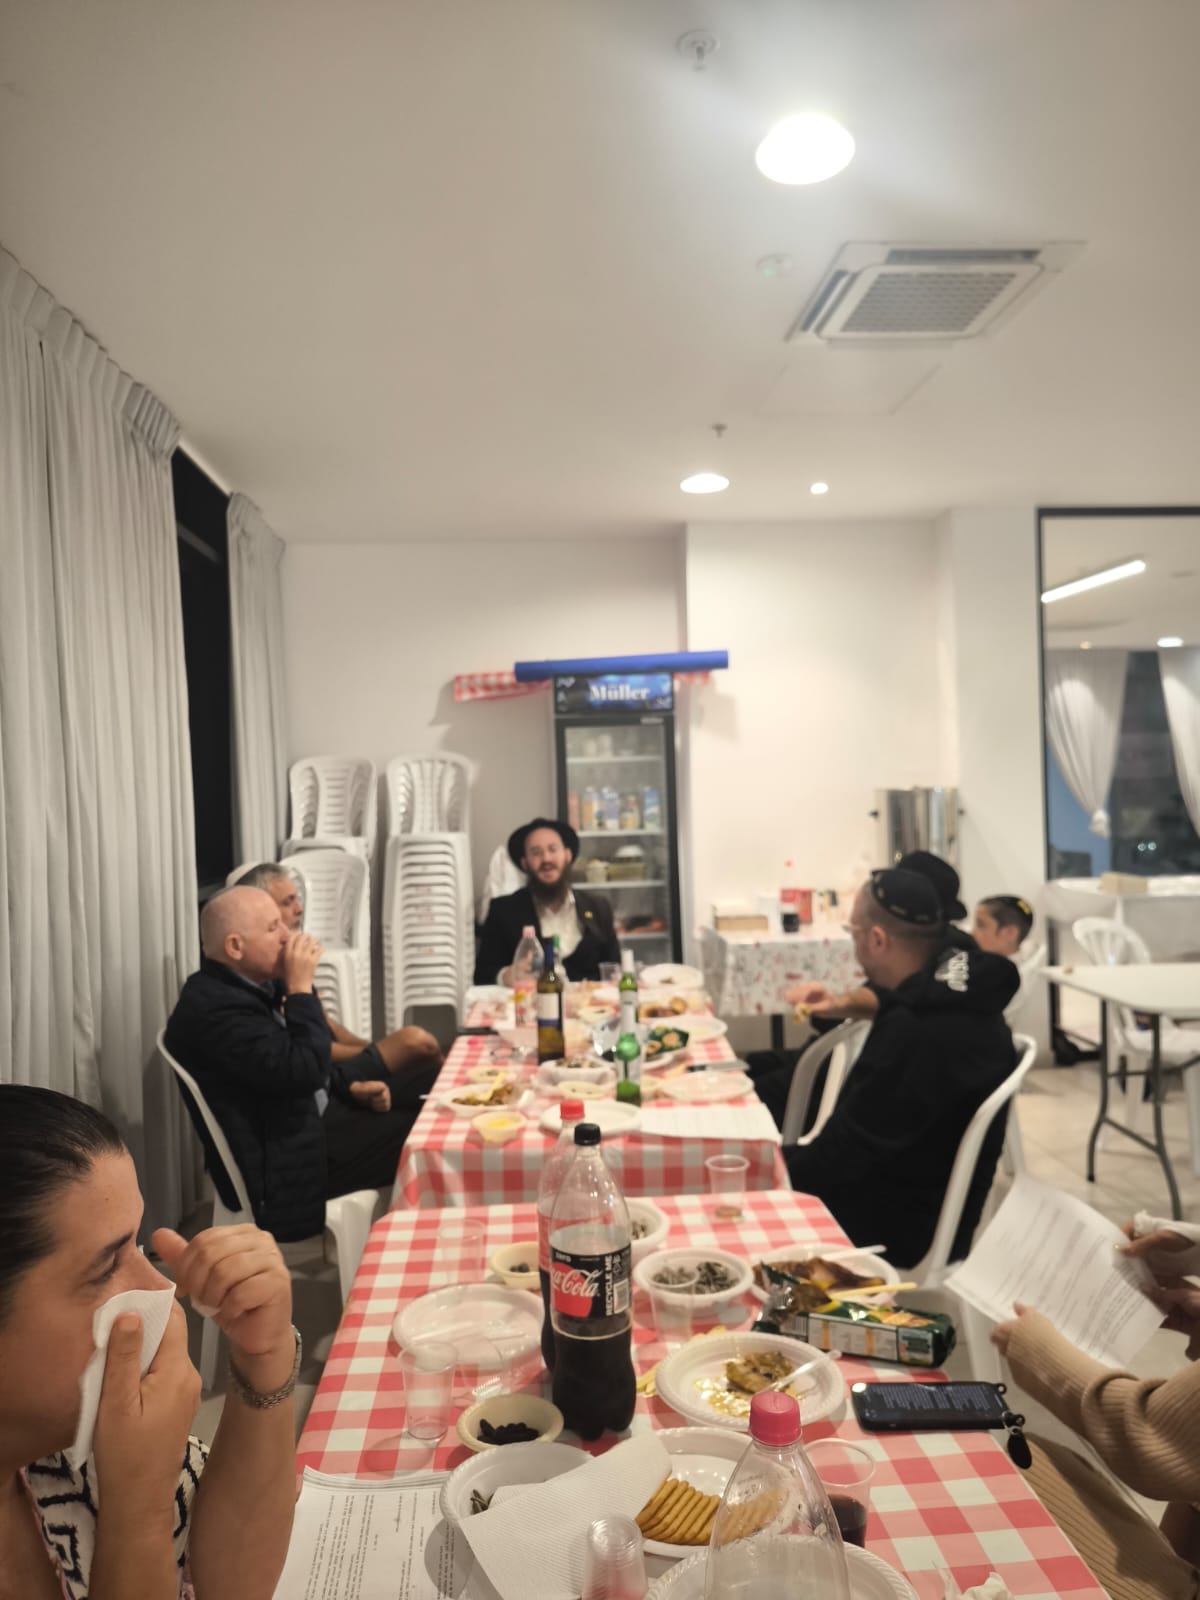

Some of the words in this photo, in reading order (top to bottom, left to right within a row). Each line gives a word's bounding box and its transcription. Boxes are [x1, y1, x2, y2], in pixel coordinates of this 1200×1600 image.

[589, 684, 650, 701] Müller
[605, 1255, 612, 1271] ME
[605, 1273, 613, 1316] RECYCLE
